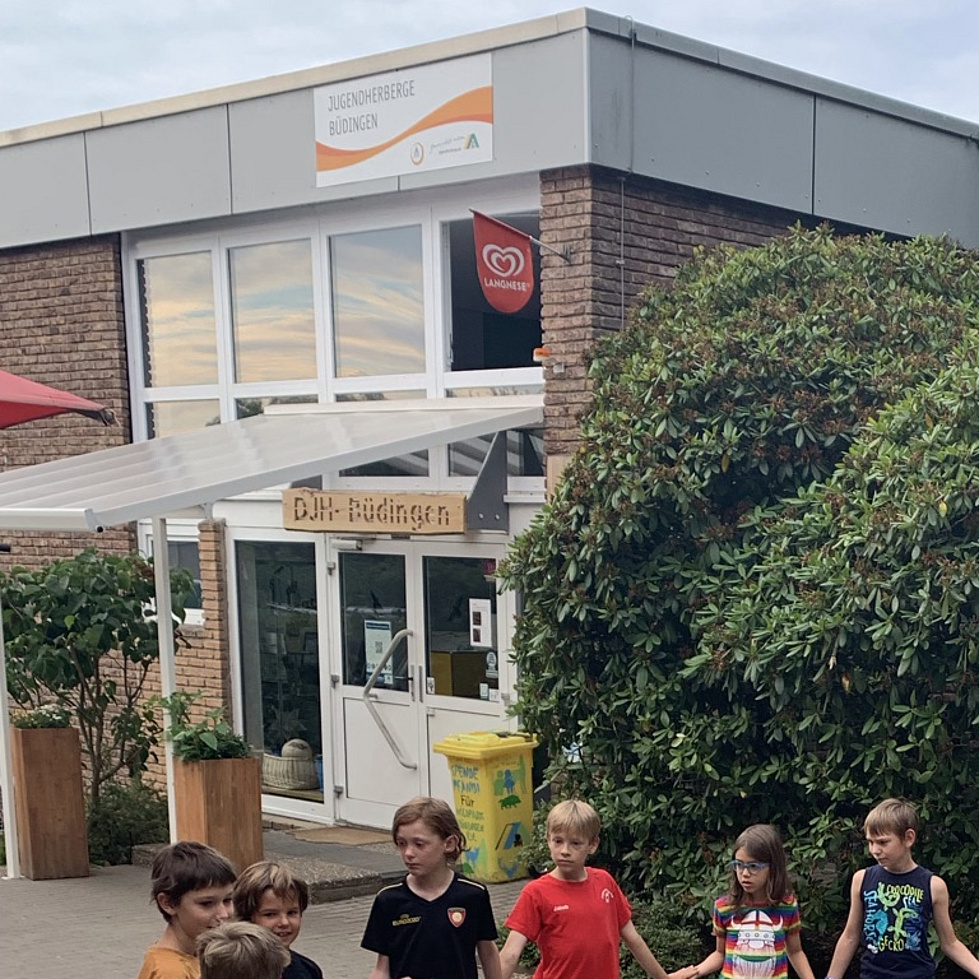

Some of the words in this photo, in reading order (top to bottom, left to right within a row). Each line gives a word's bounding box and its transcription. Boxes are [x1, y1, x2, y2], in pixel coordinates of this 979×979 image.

[327, 79, 415, 112] JUGENDHERBERGE
[329, 113, 378, 136] BÜDINGEN
[484, 277, 527, 292] LANGNESE
[349, 496, 450, 531] Büdingen
